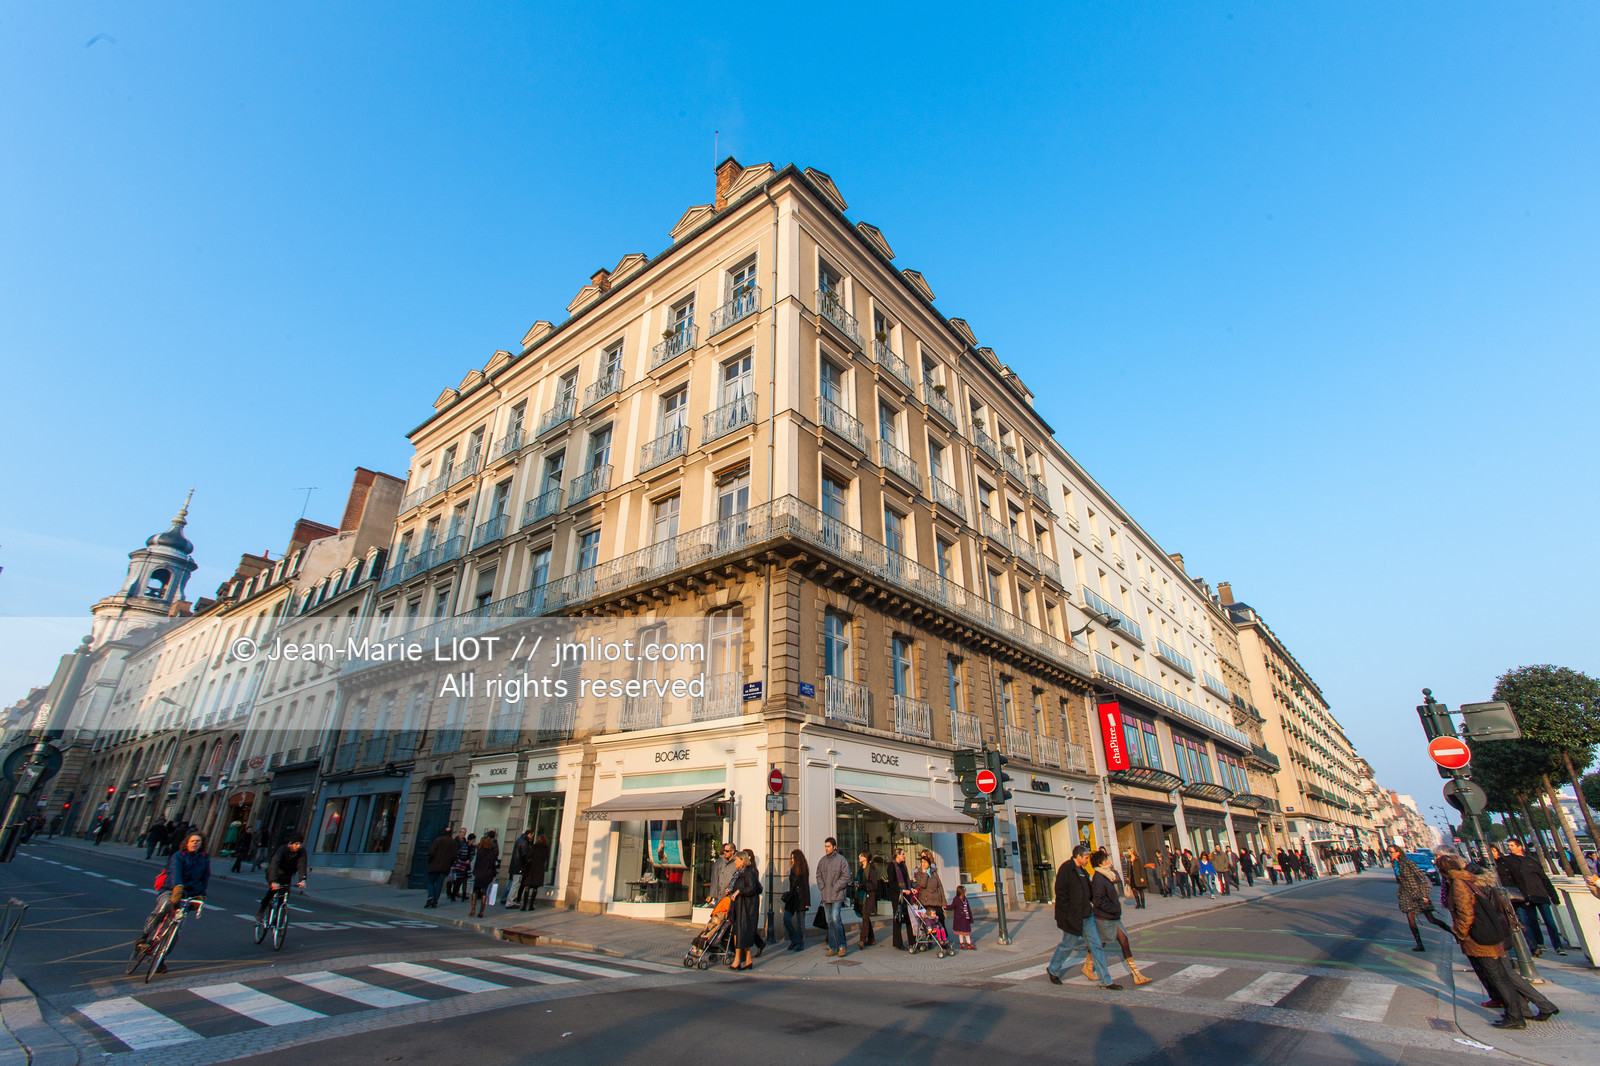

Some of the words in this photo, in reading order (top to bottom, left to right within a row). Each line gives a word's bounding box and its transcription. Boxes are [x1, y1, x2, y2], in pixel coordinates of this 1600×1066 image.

[655, 749, 691, 763] BOCAGE
[871, 752, 900, 767] BOCAGE
[538, 761, 558, 771] BOCAGE
[490, 767, 508, 776] BOCAGE
[585, 811, 609, 821] BOCAGE
[904, 822, 926, 832] BOCAGE
[288, 919, 440, 931] BUS
